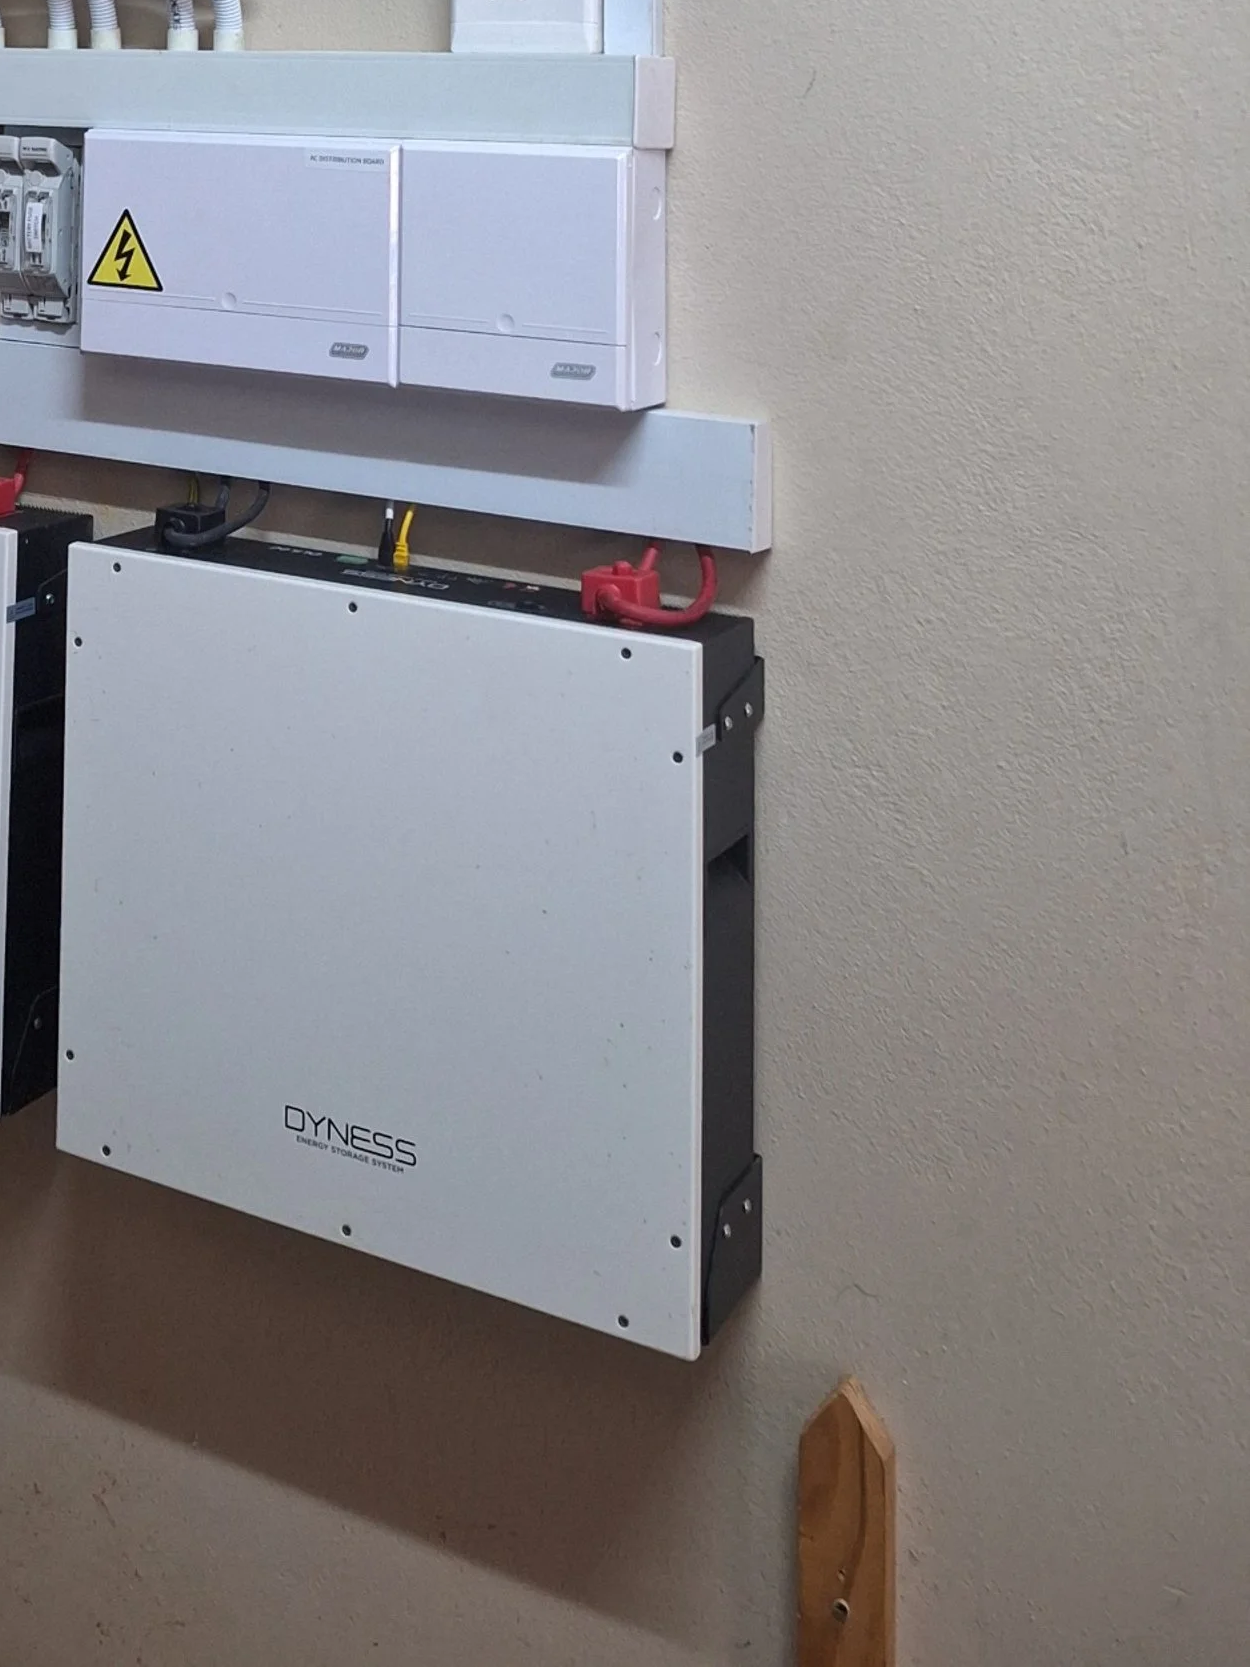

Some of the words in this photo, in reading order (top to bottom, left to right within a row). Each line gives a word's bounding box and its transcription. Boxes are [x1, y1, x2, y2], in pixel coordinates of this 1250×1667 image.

[319, 155, 361, 164] DISTRIBUTION
[363, 157, 384, 165] BOARD
[285, 1104, 417, 1167] DYNESS
[296, 1135, 329, 1151] ENERGY
[331, 1146, 369, 1164] STORAGE
[371, 1157, 404, 1174] SYSTEM
